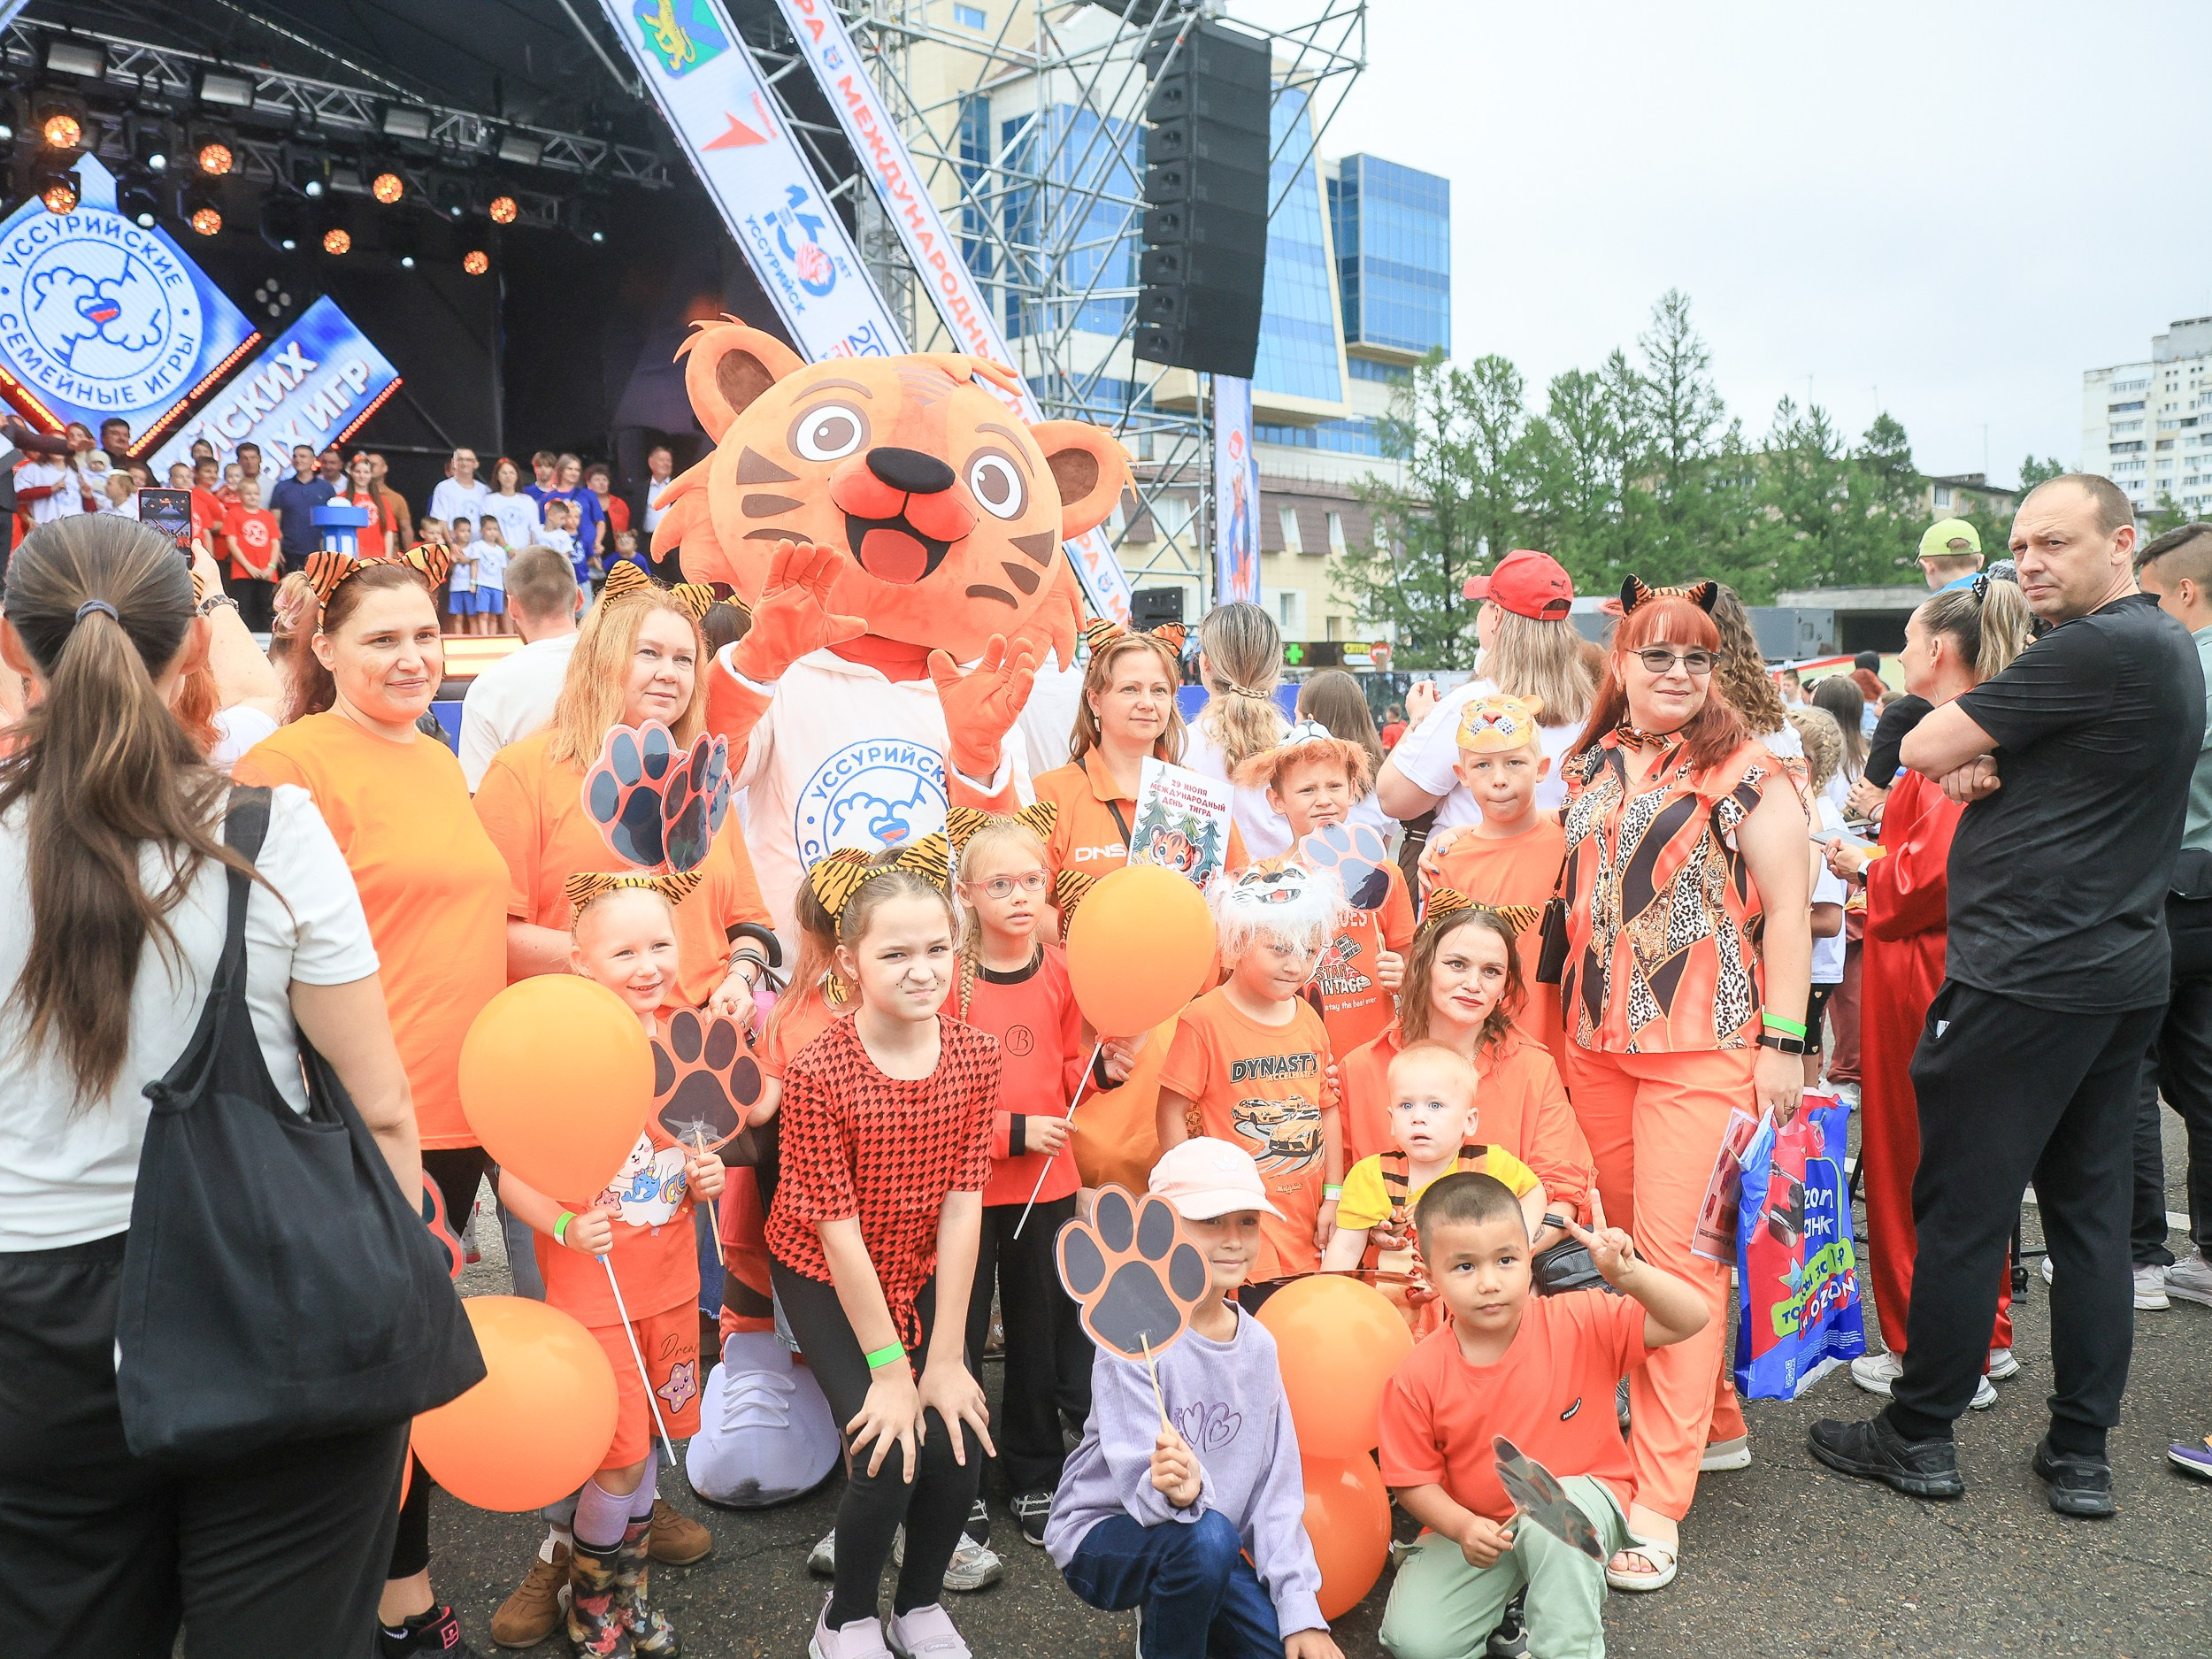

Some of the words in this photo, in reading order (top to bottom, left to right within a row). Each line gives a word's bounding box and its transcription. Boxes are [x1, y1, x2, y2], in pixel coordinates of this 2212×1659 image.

[837, 74, 1000, 391] МЕЖДУНАРОДНЫ
[3, 215, 182, 288] УССУРИЙСКИЕ
[745, 214, 806, 315] УССУРИЙСК
[833, 255, 852, 280] ЛЕТ
[1, 313, 136, 404] СЕМЕЙНЫЕ
[144, 334, 194, 394] ИГРЫ
[301, 358, 370, 433] ИГР
[811, 746, 946, 798] УССУРИЙСК
[1150, 783, 1225, 812] МЕЖДУНАРОДНЫЙ
[1184, 782, 1208, 796] ИЮЛЯ
[1162, 797, 1183, 808] ДЕНЬ
[1189, 804, 1211, 818] ТИГРА
[1075, 843, 1127, 862] DNS
[1316, 964, 1347, 980] STAR
[1318, 975, 1363, 995] INTAGE
[1325, 1002, 1340, 1012] stay
[1341, 1001, 1352, 1010] the
[1266, 1071, 1316, 1083] ACCELERATES
[1804, 1187, 1833, 1210] zon
[1804, 1216, 1834, 1239] анк
[1811, 1277, 1855, 1317] OZON
